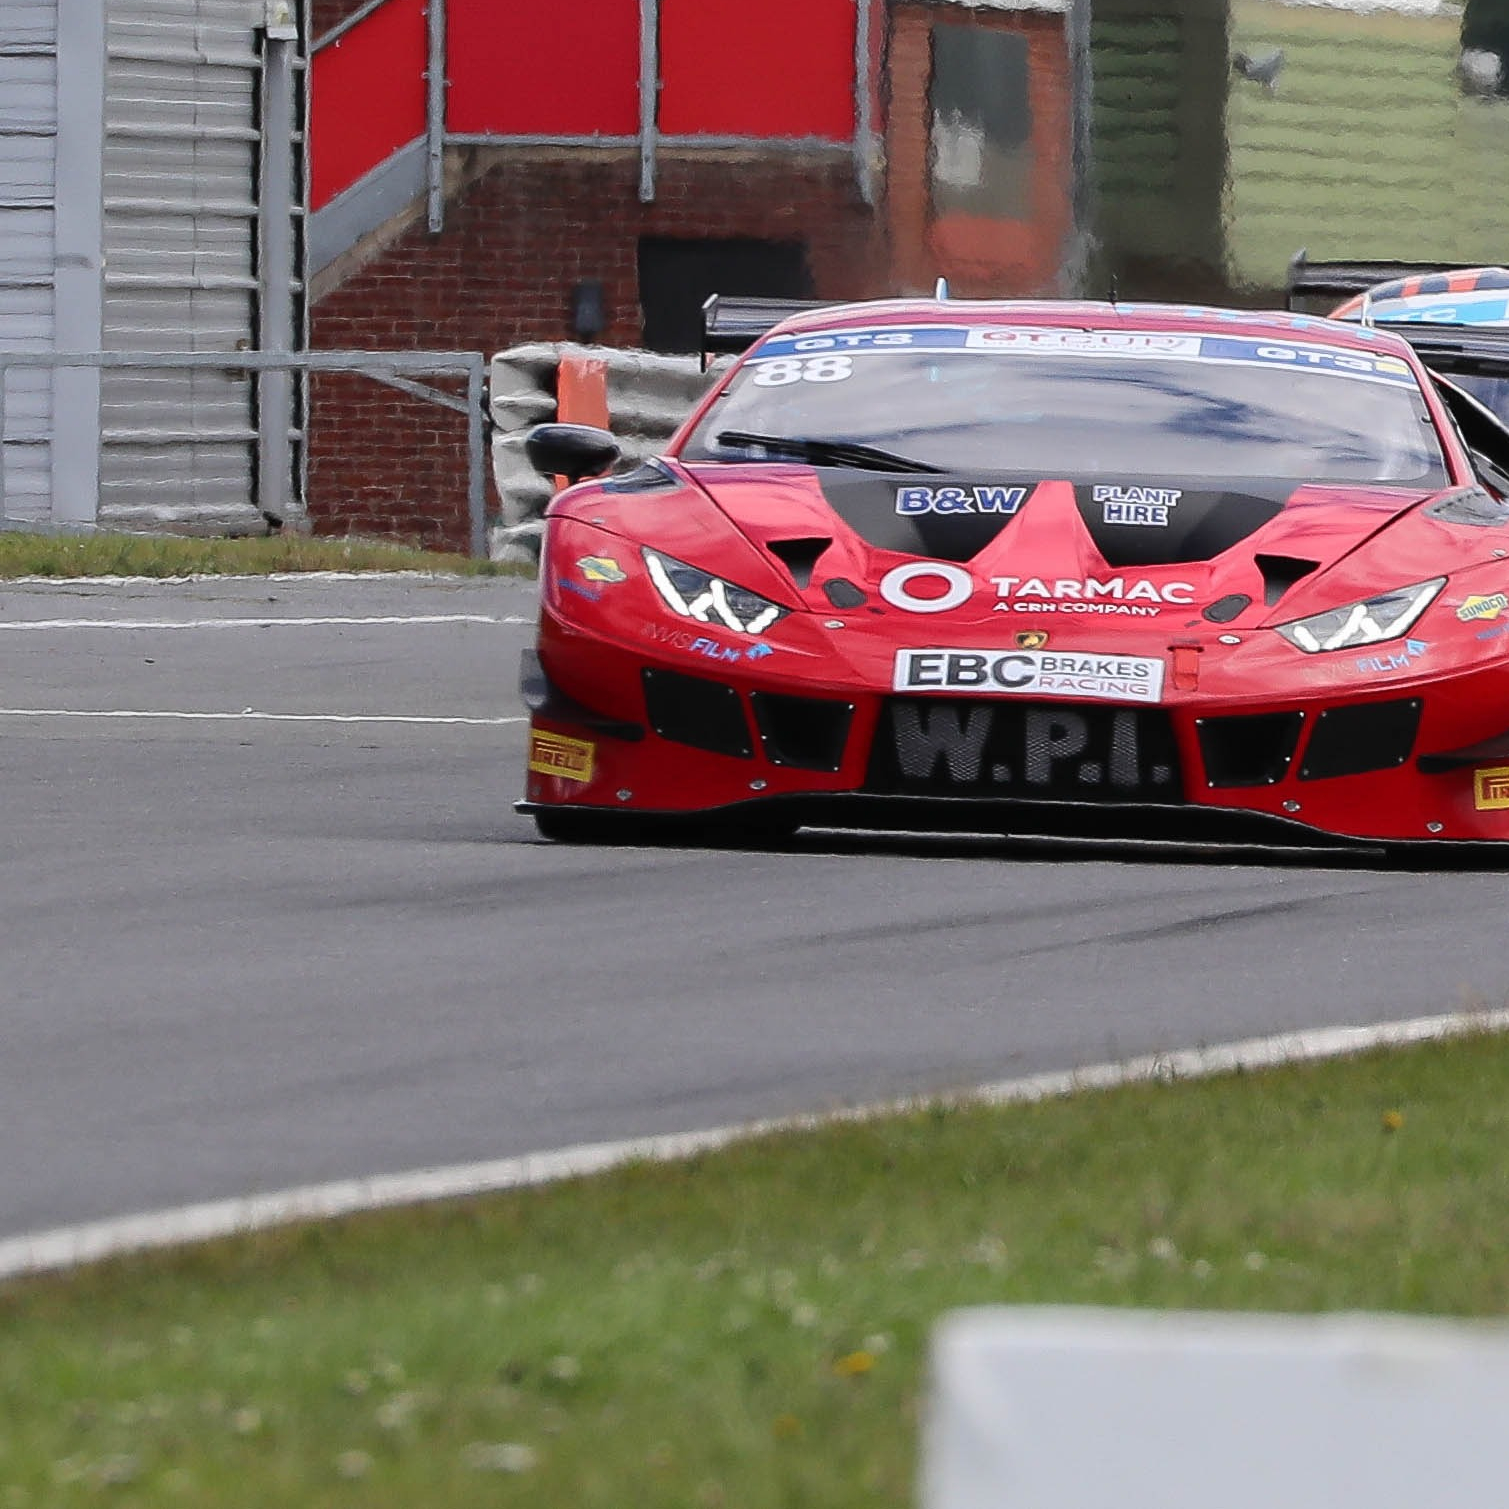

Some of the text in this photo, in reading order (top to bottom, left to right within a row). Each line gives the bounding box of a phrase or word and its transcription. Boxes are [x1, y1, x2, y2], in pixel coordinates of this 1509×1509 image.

[794, 332, 914, 351] GT3
[752, 355, 852, 387] 88
[1255, 345, 1374, 372] GT3
[896, 486, 1027, 515] B&W
[1093, 485, 1182, 507] PLANT
[1103, 503, 1169, 527] HIRE
[990, 577, 1195, 605] TARMAC
[992, 602, 1160, 618] A CRH COMPANY
[1458, 594, 1508, 620] SUNOCO
[907, 653, 1037, 688] EBC
[1040, 656, 1150, 678] BRAKES
[1039, 675, 1150, 696] RACING
[892, 703, 1171, 786] W.P.I.
